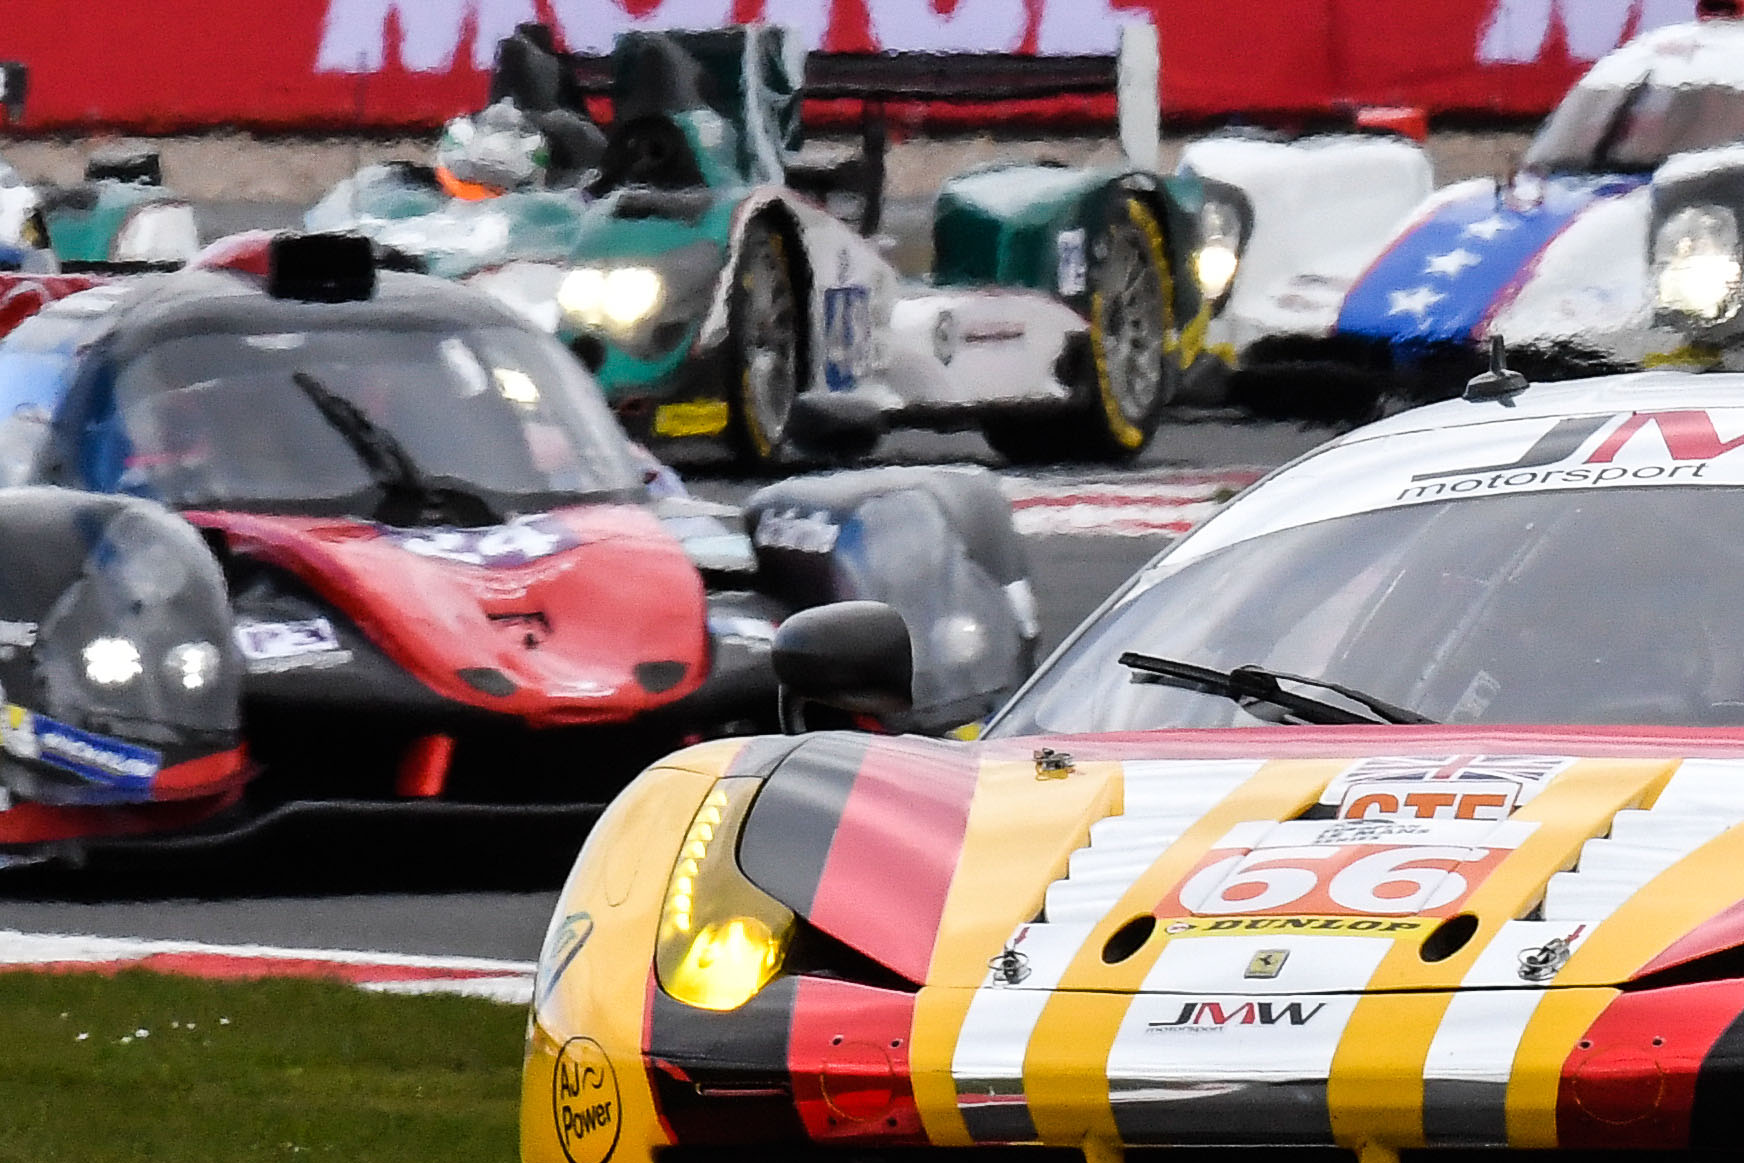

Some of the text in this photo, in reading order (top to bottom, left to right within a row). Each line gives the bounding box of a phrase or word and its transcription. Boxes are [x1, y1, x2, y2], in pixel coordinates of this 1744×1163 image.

[1397, 461, 1706, 500] motorsport
[1178, 845, 1490, 915] 66
[1202, 918, 1421, 934] DUNLOP
[1149, 1002, 1326, 1025] JMW
[561, 1061, 579, 1100] AJ
[562, 1101, 611, 1150] Power
